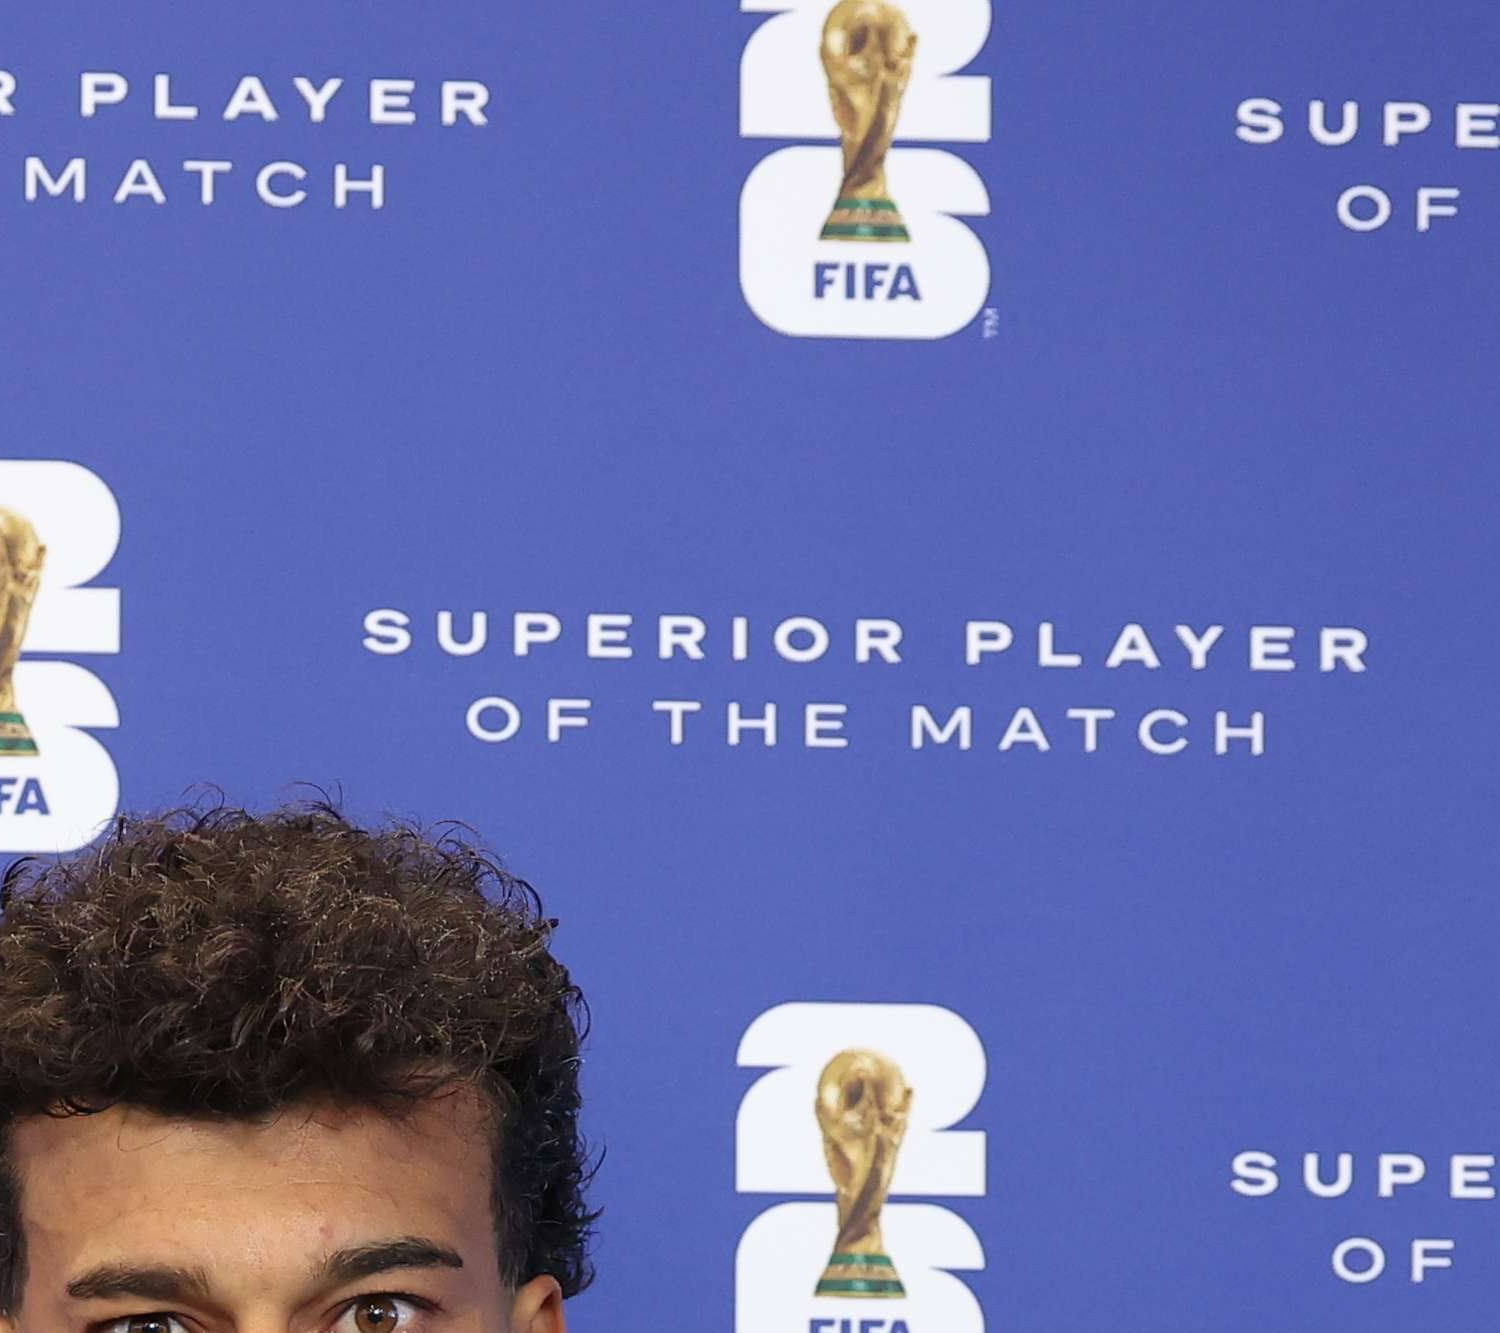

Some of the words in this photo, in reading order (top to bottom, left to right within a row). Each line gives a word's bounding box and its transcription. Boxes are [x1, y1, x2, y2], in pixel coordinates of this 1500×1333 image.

[80, 72, 489, 126] PLAYER
[25, 156, 384, 209] MATCH
[1337, 185, 1460, 232] OF
[813, 261, 922, 302] FIFA
[363, 609, 903, 664] SUPERIOR
[966, 621, 1368, 673] PLAYER
[466, 696, 591, 742] OF
[652, 700, 848, 748] THE
[911, 705, 1264, 756] MATCH
[1332, 1237, 1455, 1283] OF
